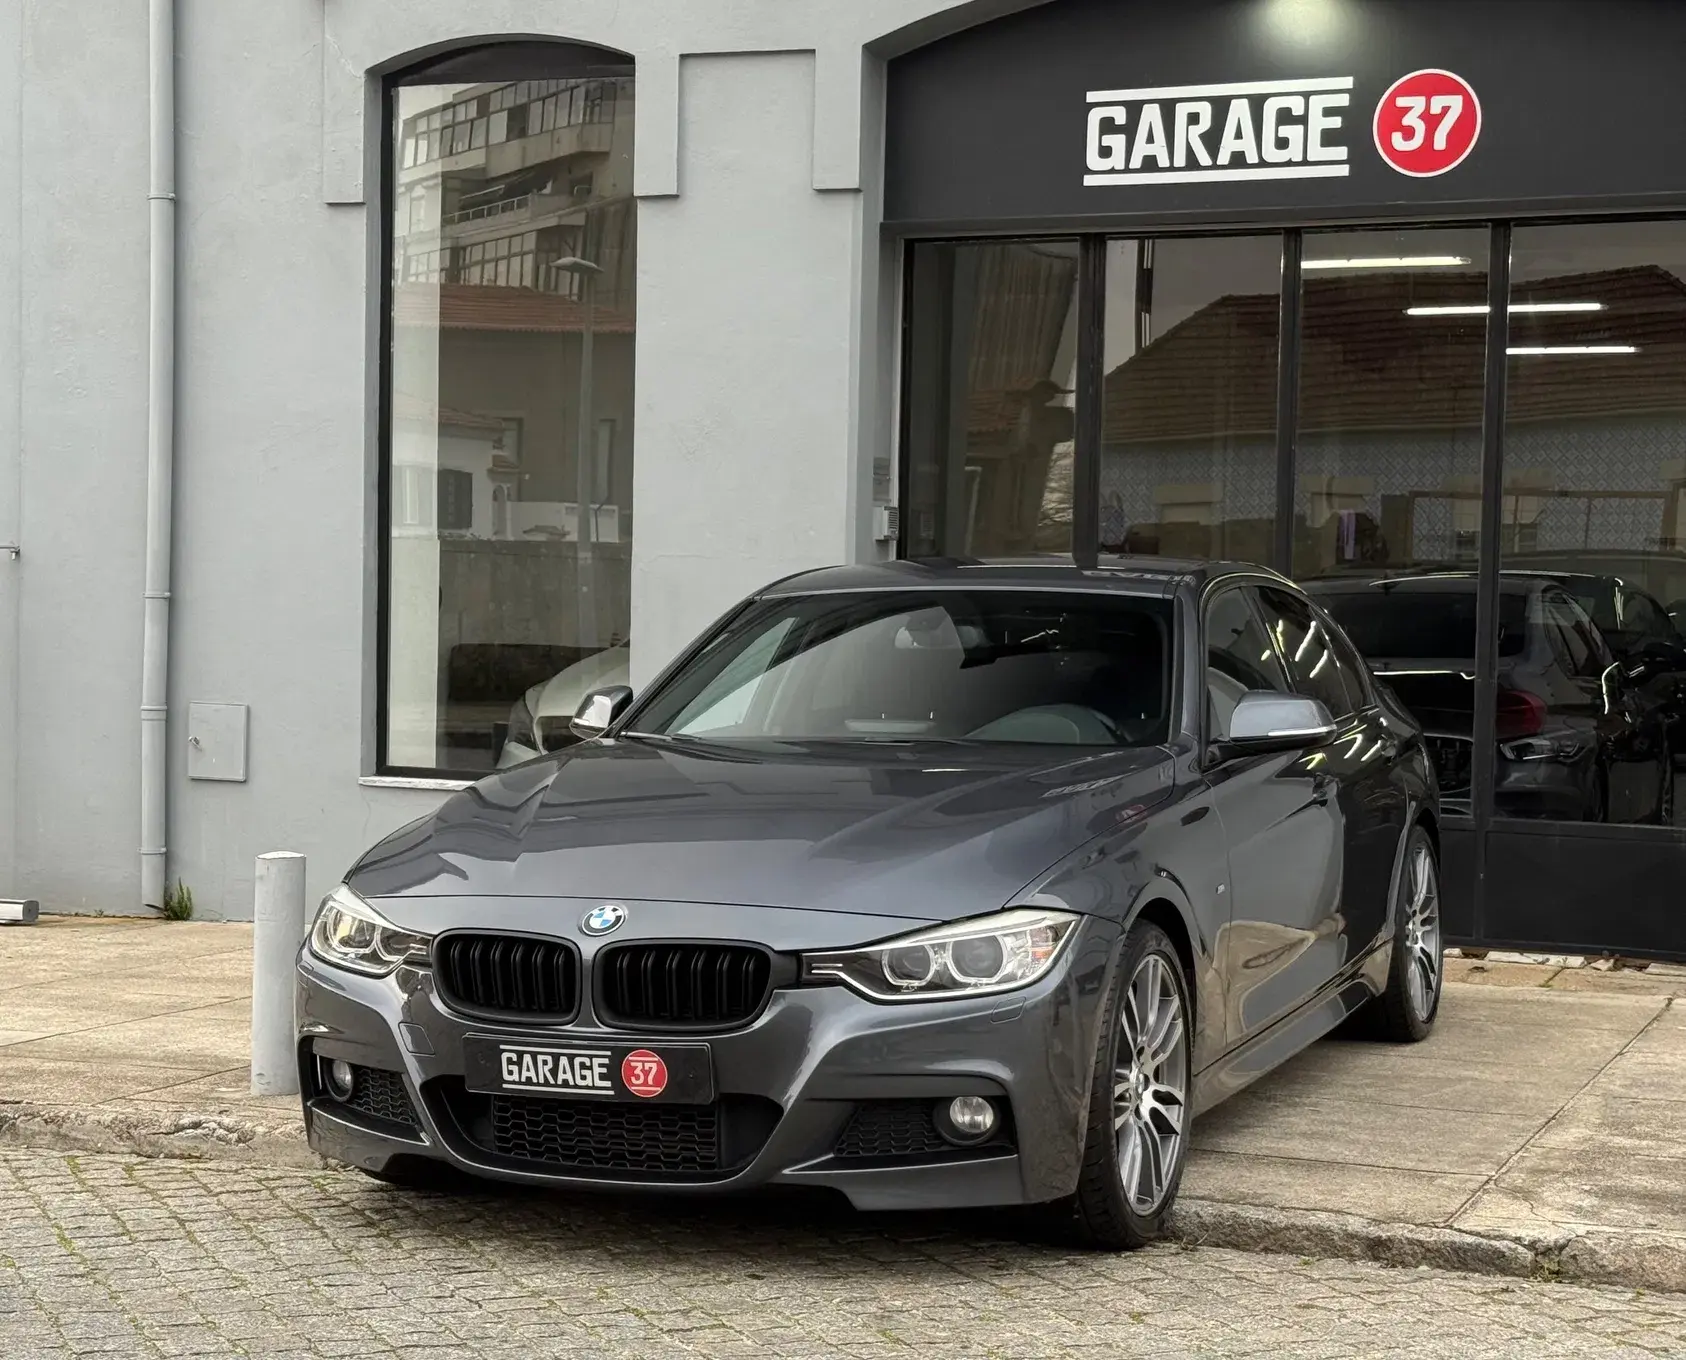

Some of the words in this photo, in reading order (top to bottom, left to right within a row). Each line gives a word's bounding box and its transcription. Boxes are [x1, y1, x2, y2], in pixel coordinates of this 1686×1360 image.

[1086, 93, 1350, 171] GARAGE
[1391, 94, 1464, 151] 37
[501, 1051, 612, 1087] GARAGE
[630, 1062, 658, 1085] 37
